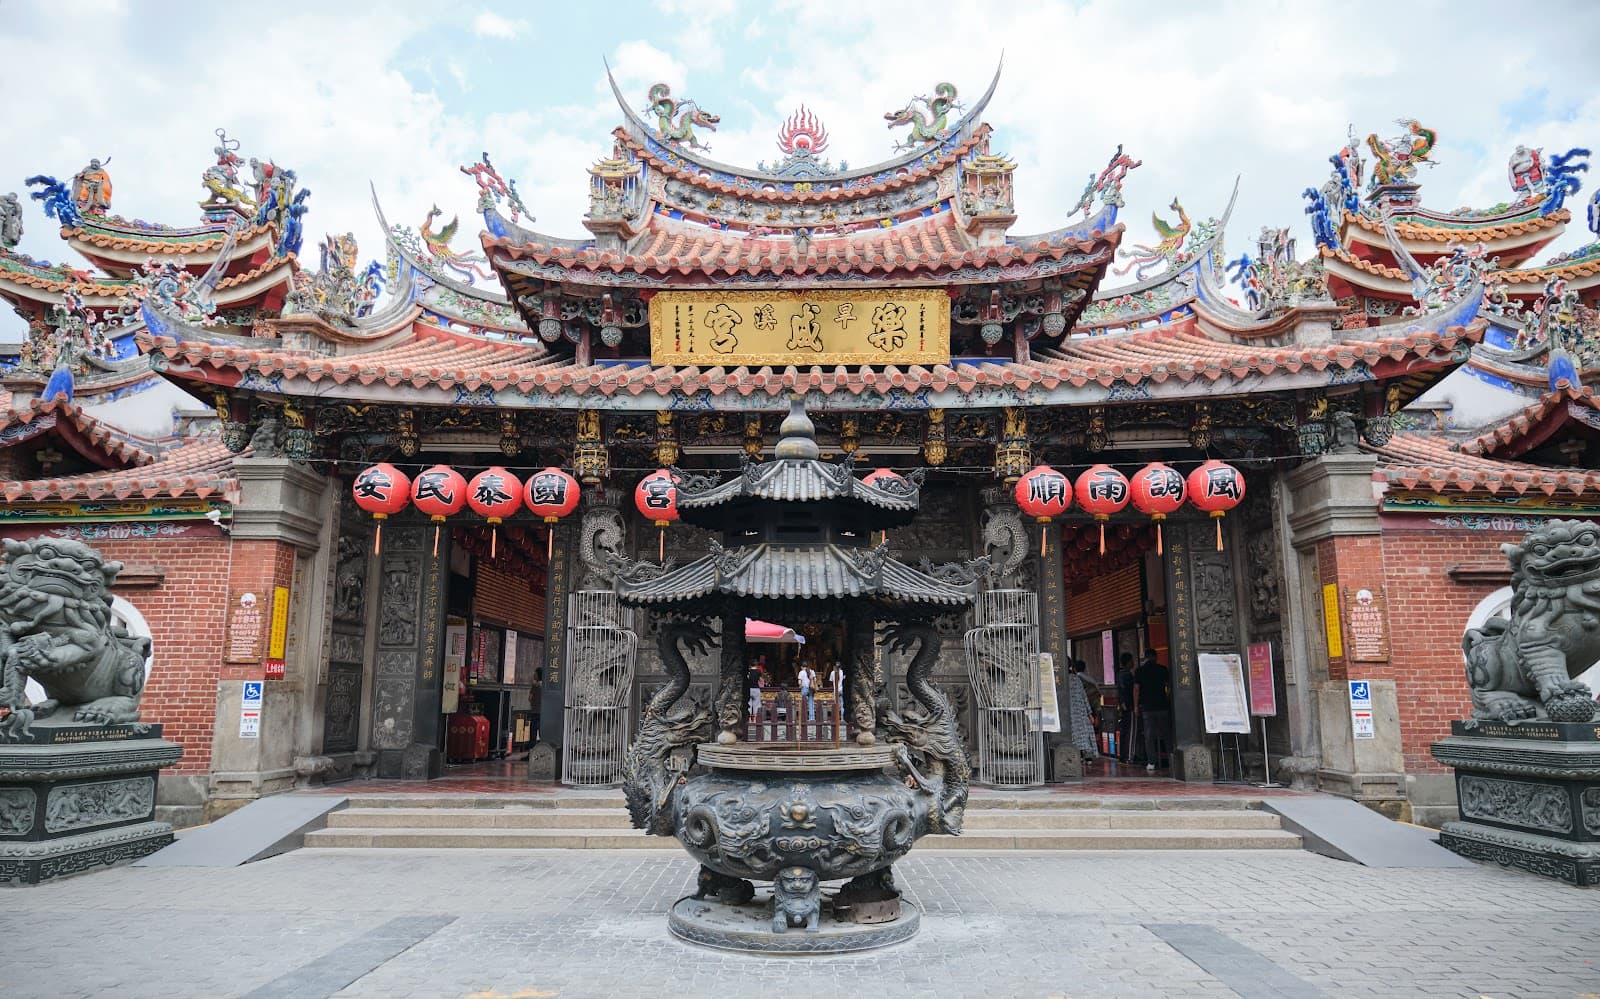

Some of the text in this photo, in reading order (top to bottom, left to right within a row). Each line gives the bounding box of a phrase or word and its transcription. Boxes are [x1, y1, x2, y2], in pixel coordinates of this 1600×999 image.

[354, 469, 392, 501] 安
[415, 472, 453, 505] 民
[473, 474, 512, 505] 泰
[529, 473, 567, 506] 國
[641, 476, 674, 509] 宮
[1028, 473, 1065, 506] 順
[1089, 471, 1126, 504] 雨
[1146, 469, 1183, 501] 調
[1205, 467, 1242, 500] 風
